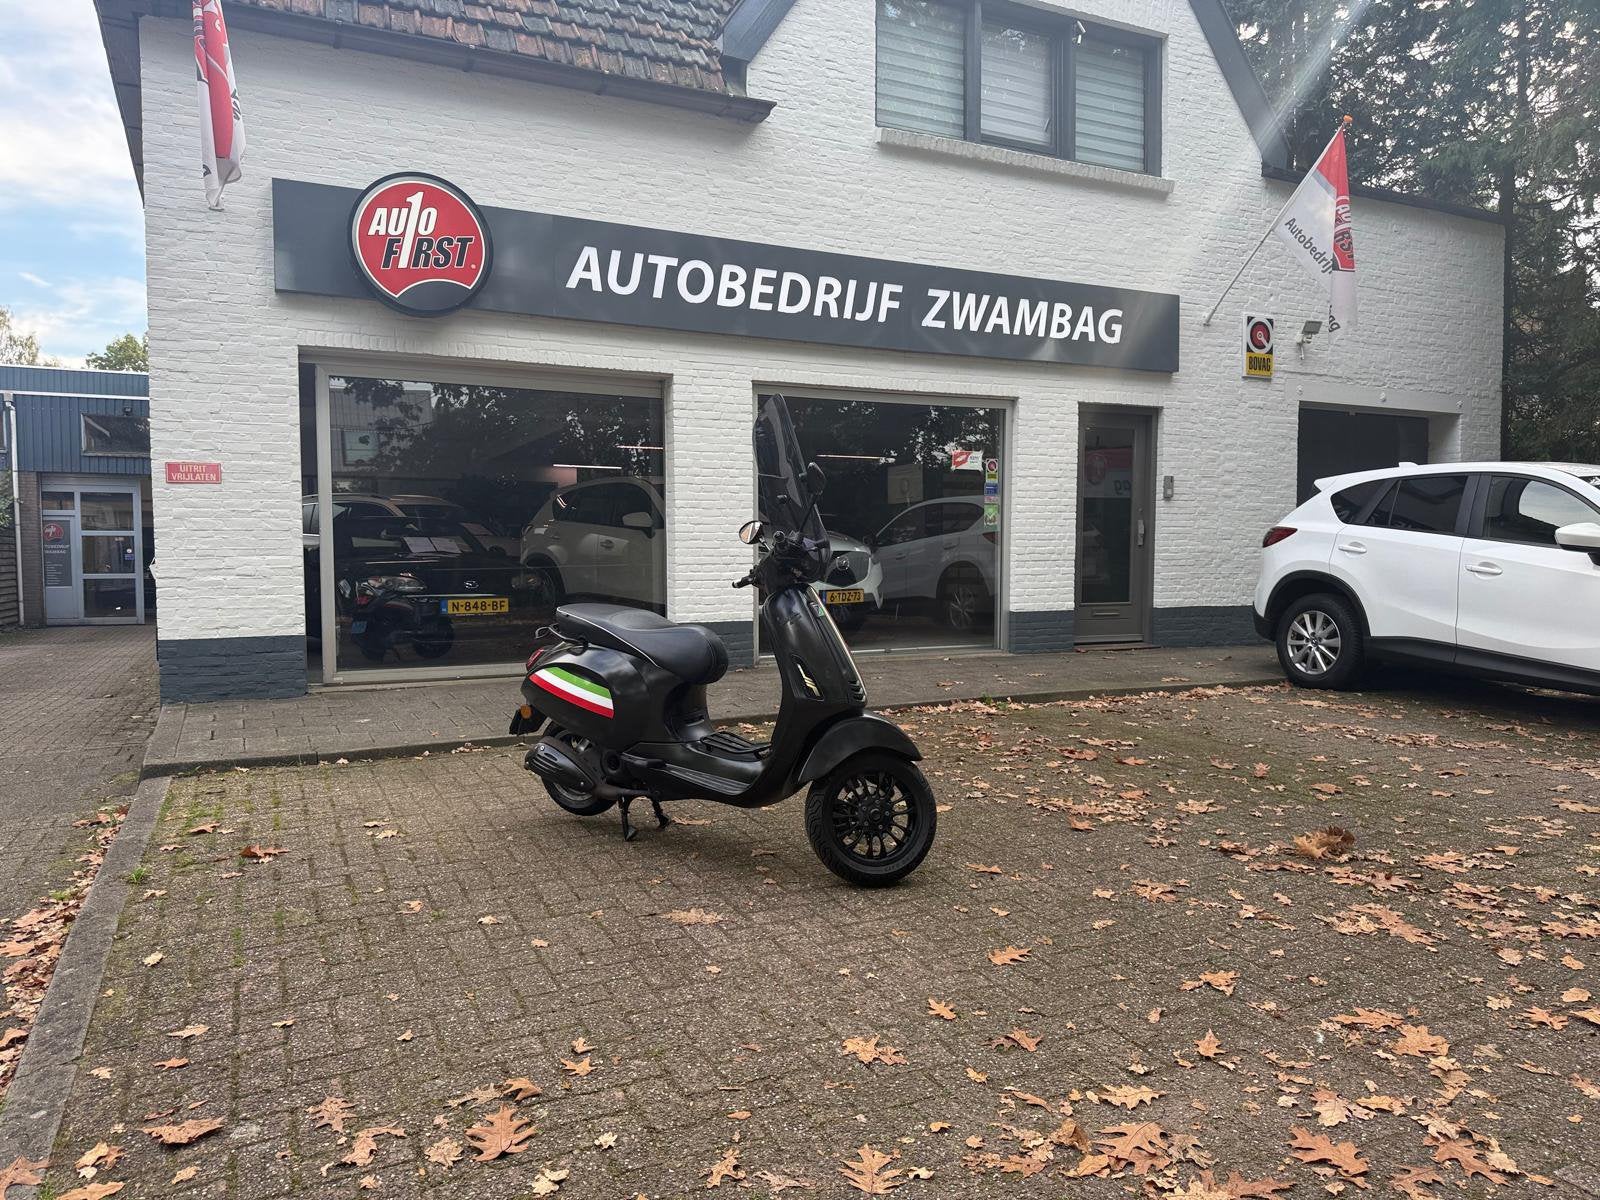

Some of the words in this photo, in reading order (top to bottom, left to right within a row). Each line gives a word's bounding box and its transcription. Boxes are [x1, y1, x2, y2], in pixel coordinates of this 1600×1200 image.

[1284, 217, 1333, 275] Autobedrij
[565, 245, 903, 324] AUTOBEDRIJF
[920, 288, 1124, 345] ZWAMBAG
[1248, 356, 1271, 372] BOVAG
[179, 464, 206, 473] UITRIT
[171, 472, 217, 481] VRIJLATEN
[451, 600, 506, 612] N-848-BF
